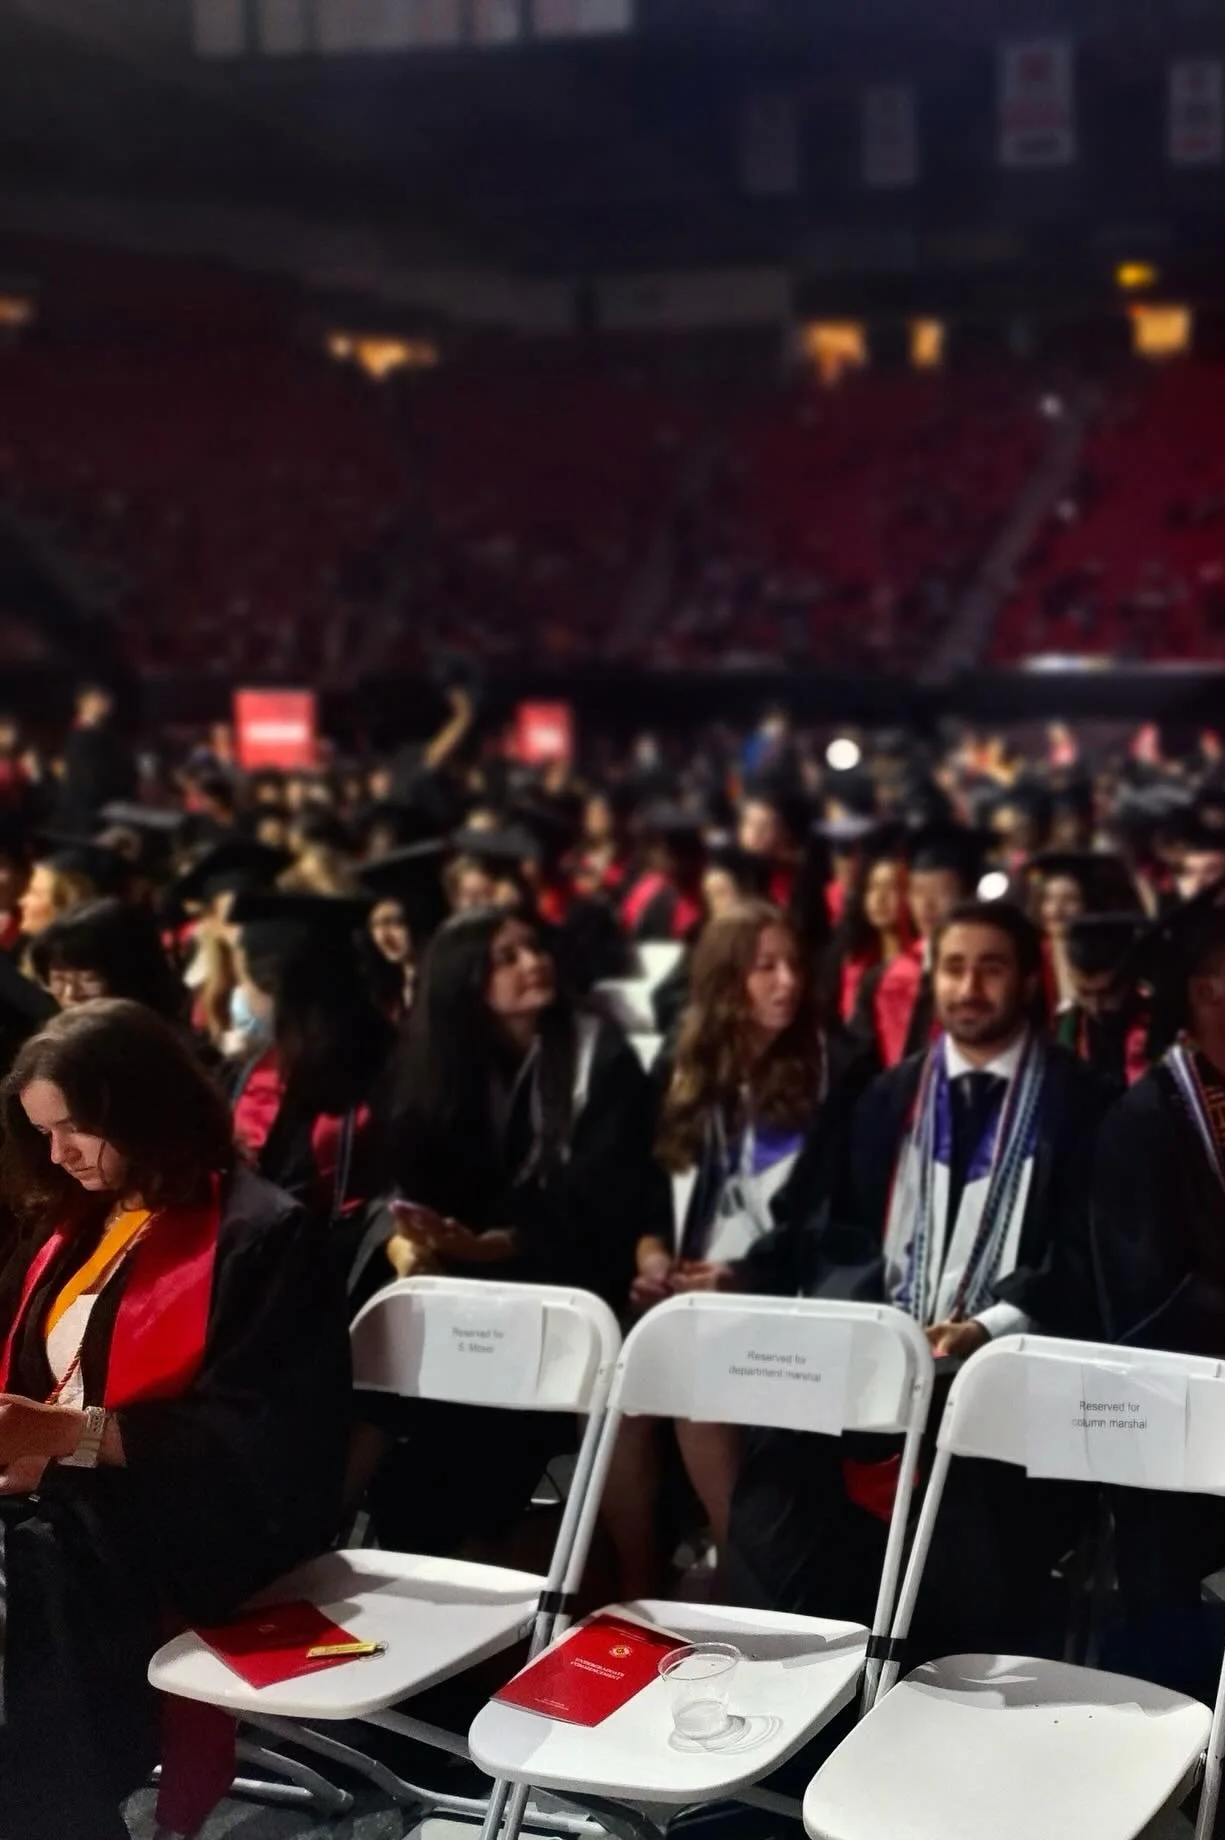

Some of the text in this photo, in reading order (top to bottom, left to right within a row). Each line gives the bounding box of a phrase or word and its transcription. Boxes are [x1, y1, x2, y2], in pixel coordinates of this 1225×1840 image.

[746, 1350, 792, 1364] Reserved
[728, 1364, 782, 1379] department
[1080, 1401, 1140, 1412] Reserved for
[1070, 1417, 1147, 1429] column marshal
